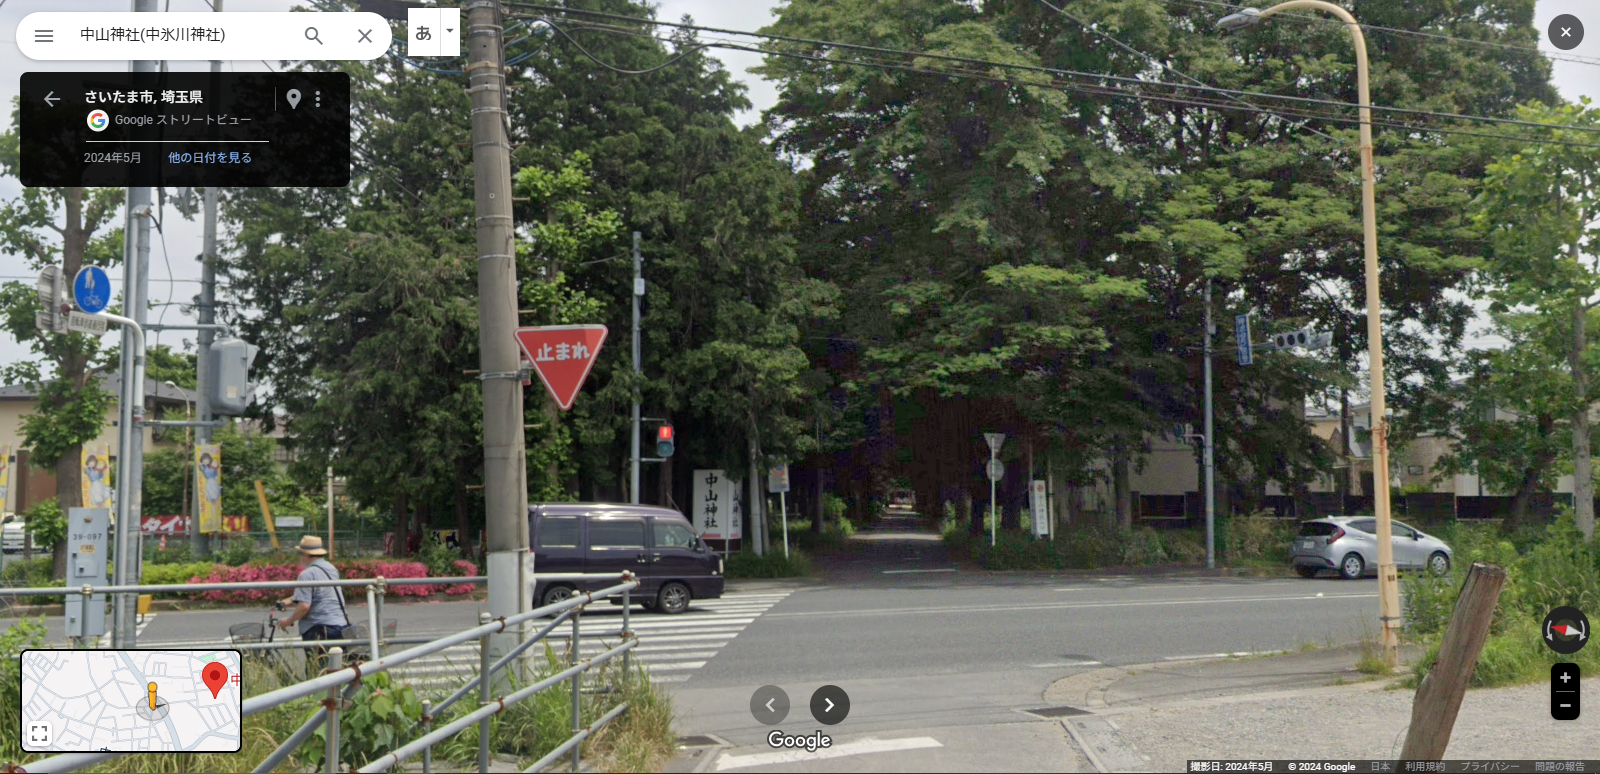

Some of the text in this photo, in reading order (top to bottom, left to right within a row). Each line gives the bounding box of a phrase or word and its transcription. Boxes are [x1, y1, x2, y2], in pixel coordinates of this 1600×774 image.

[535, 341, 591, 362] 止まれ
[703, 471, 719, 530] 中山神社
[72, 533, 102, 541] 39-097
